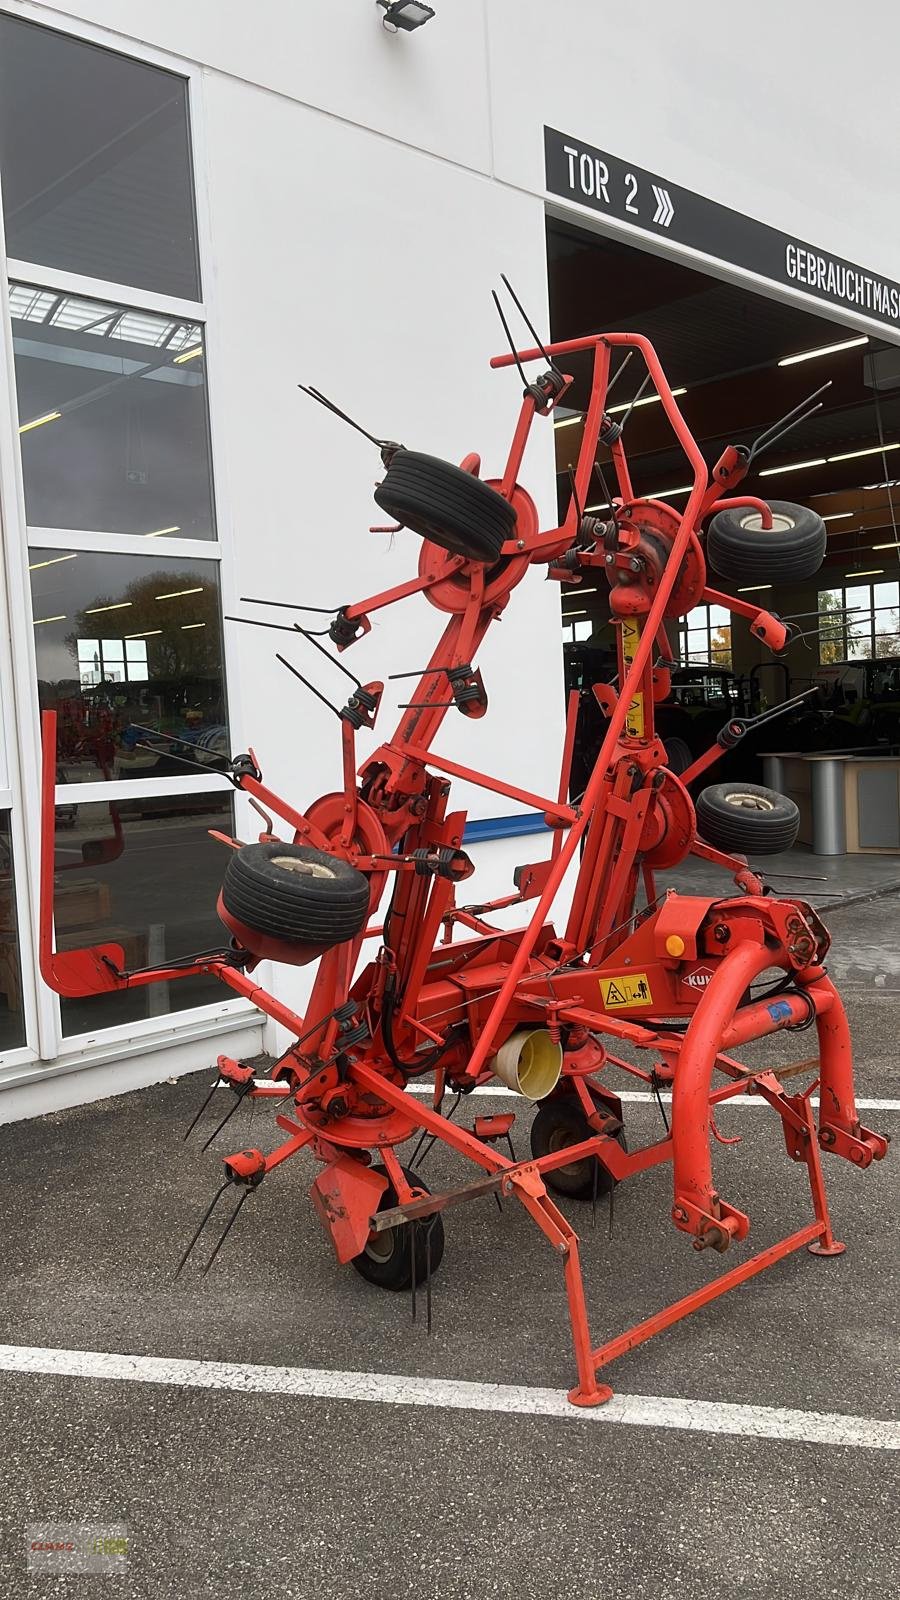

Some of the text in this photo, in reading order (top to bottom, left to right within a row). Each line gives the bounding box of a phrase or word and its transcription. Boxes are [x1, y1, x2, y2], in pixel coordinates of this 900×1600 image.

[563, 145, 639, 215] TOR 2
[786, 244, 900, 319] GEBRAUCHTMAS
[688, 975, 712, 986] KUH
